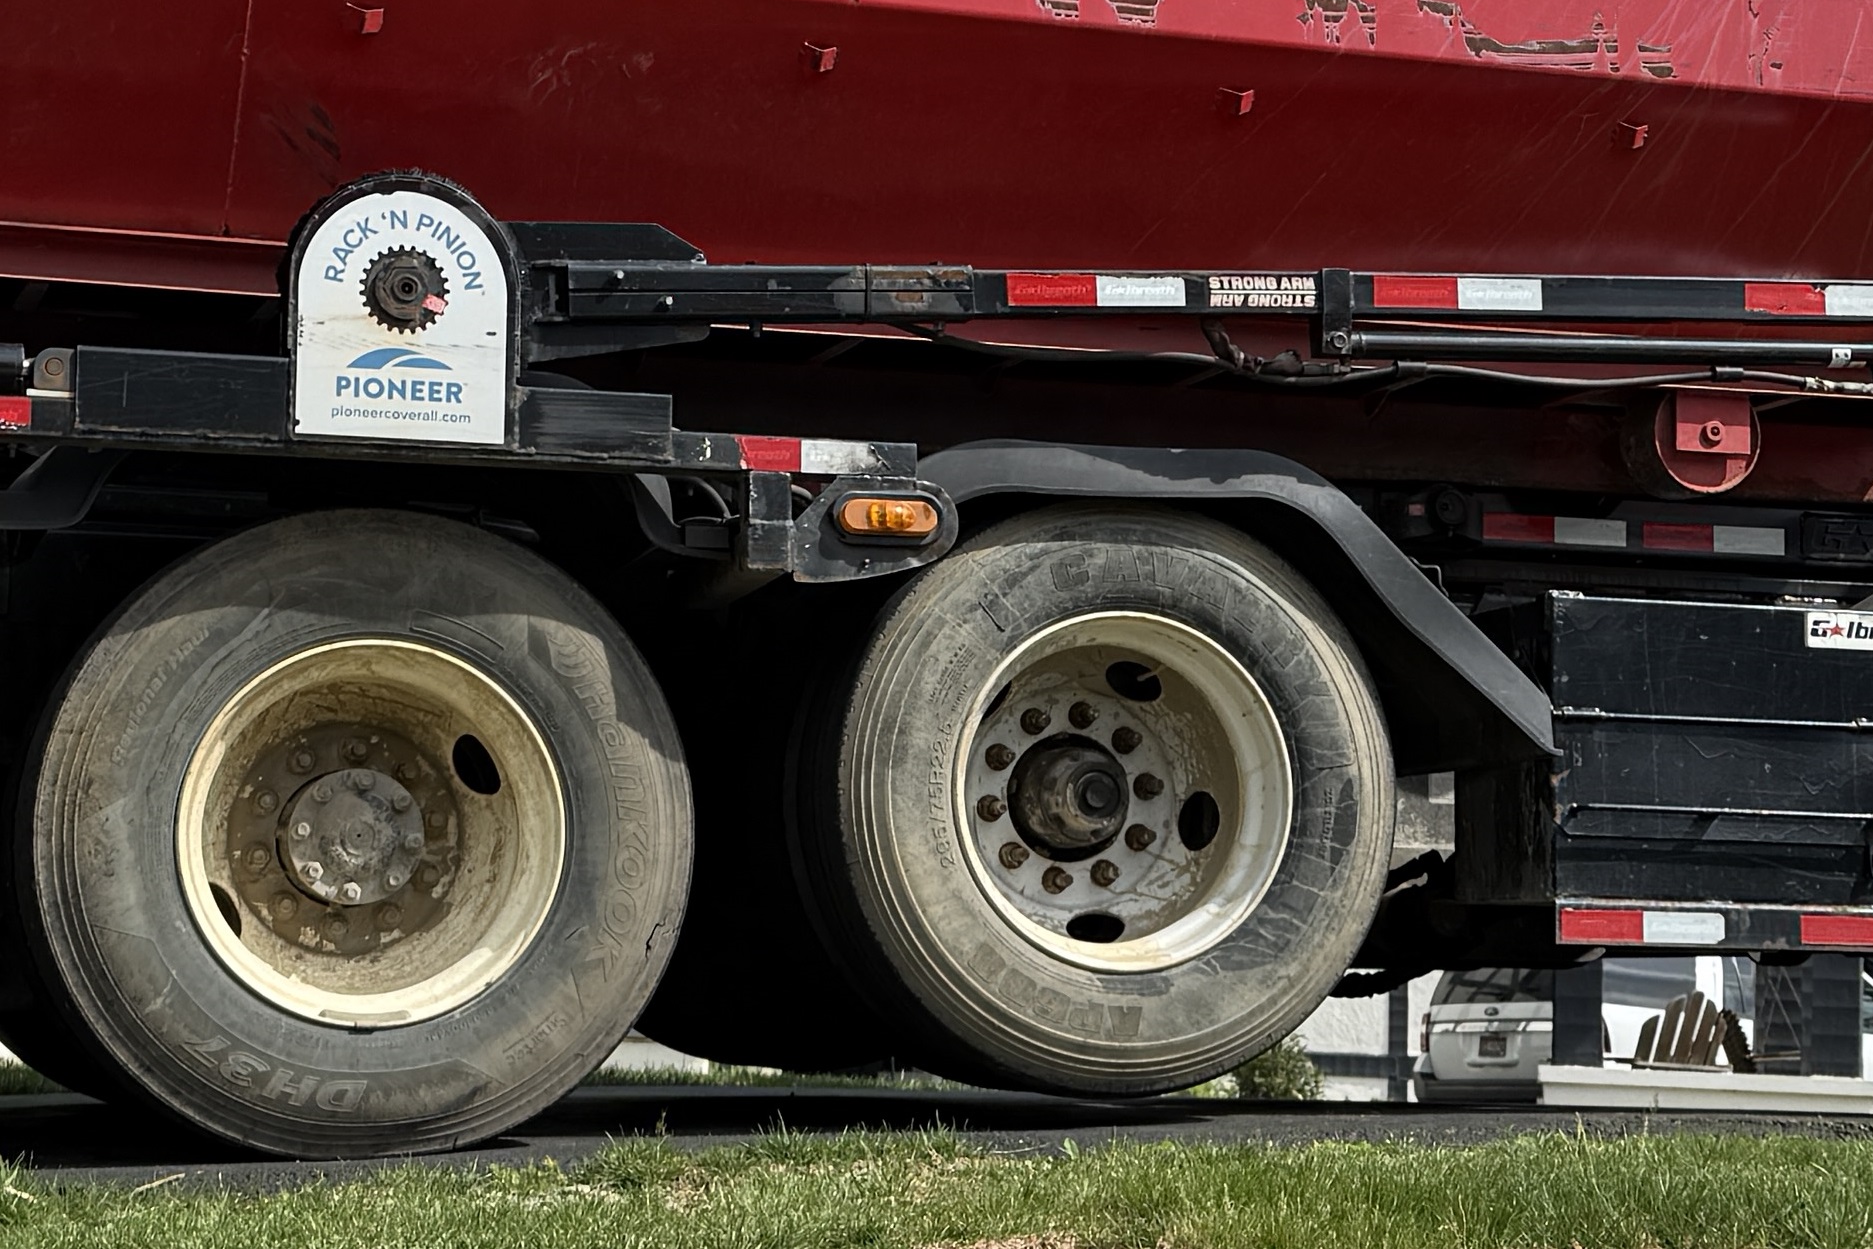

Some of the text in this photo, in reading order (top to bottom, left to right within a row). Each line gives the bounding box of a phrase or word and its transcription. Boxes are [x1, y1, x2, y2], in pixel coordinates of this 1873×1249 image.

[324, 216, 379, 283] RACK
[415, 212, 485, 292] PINION
[1208, 276, 1316, 290] STRONG ARM
[1210, 294, 1317, 307] STRONG ARM
[335, 375, 464, 404] PIONEER
[331, 404, 471, 424] pioneercoverall.com
[179, 1034, 368, 1113] DH37
